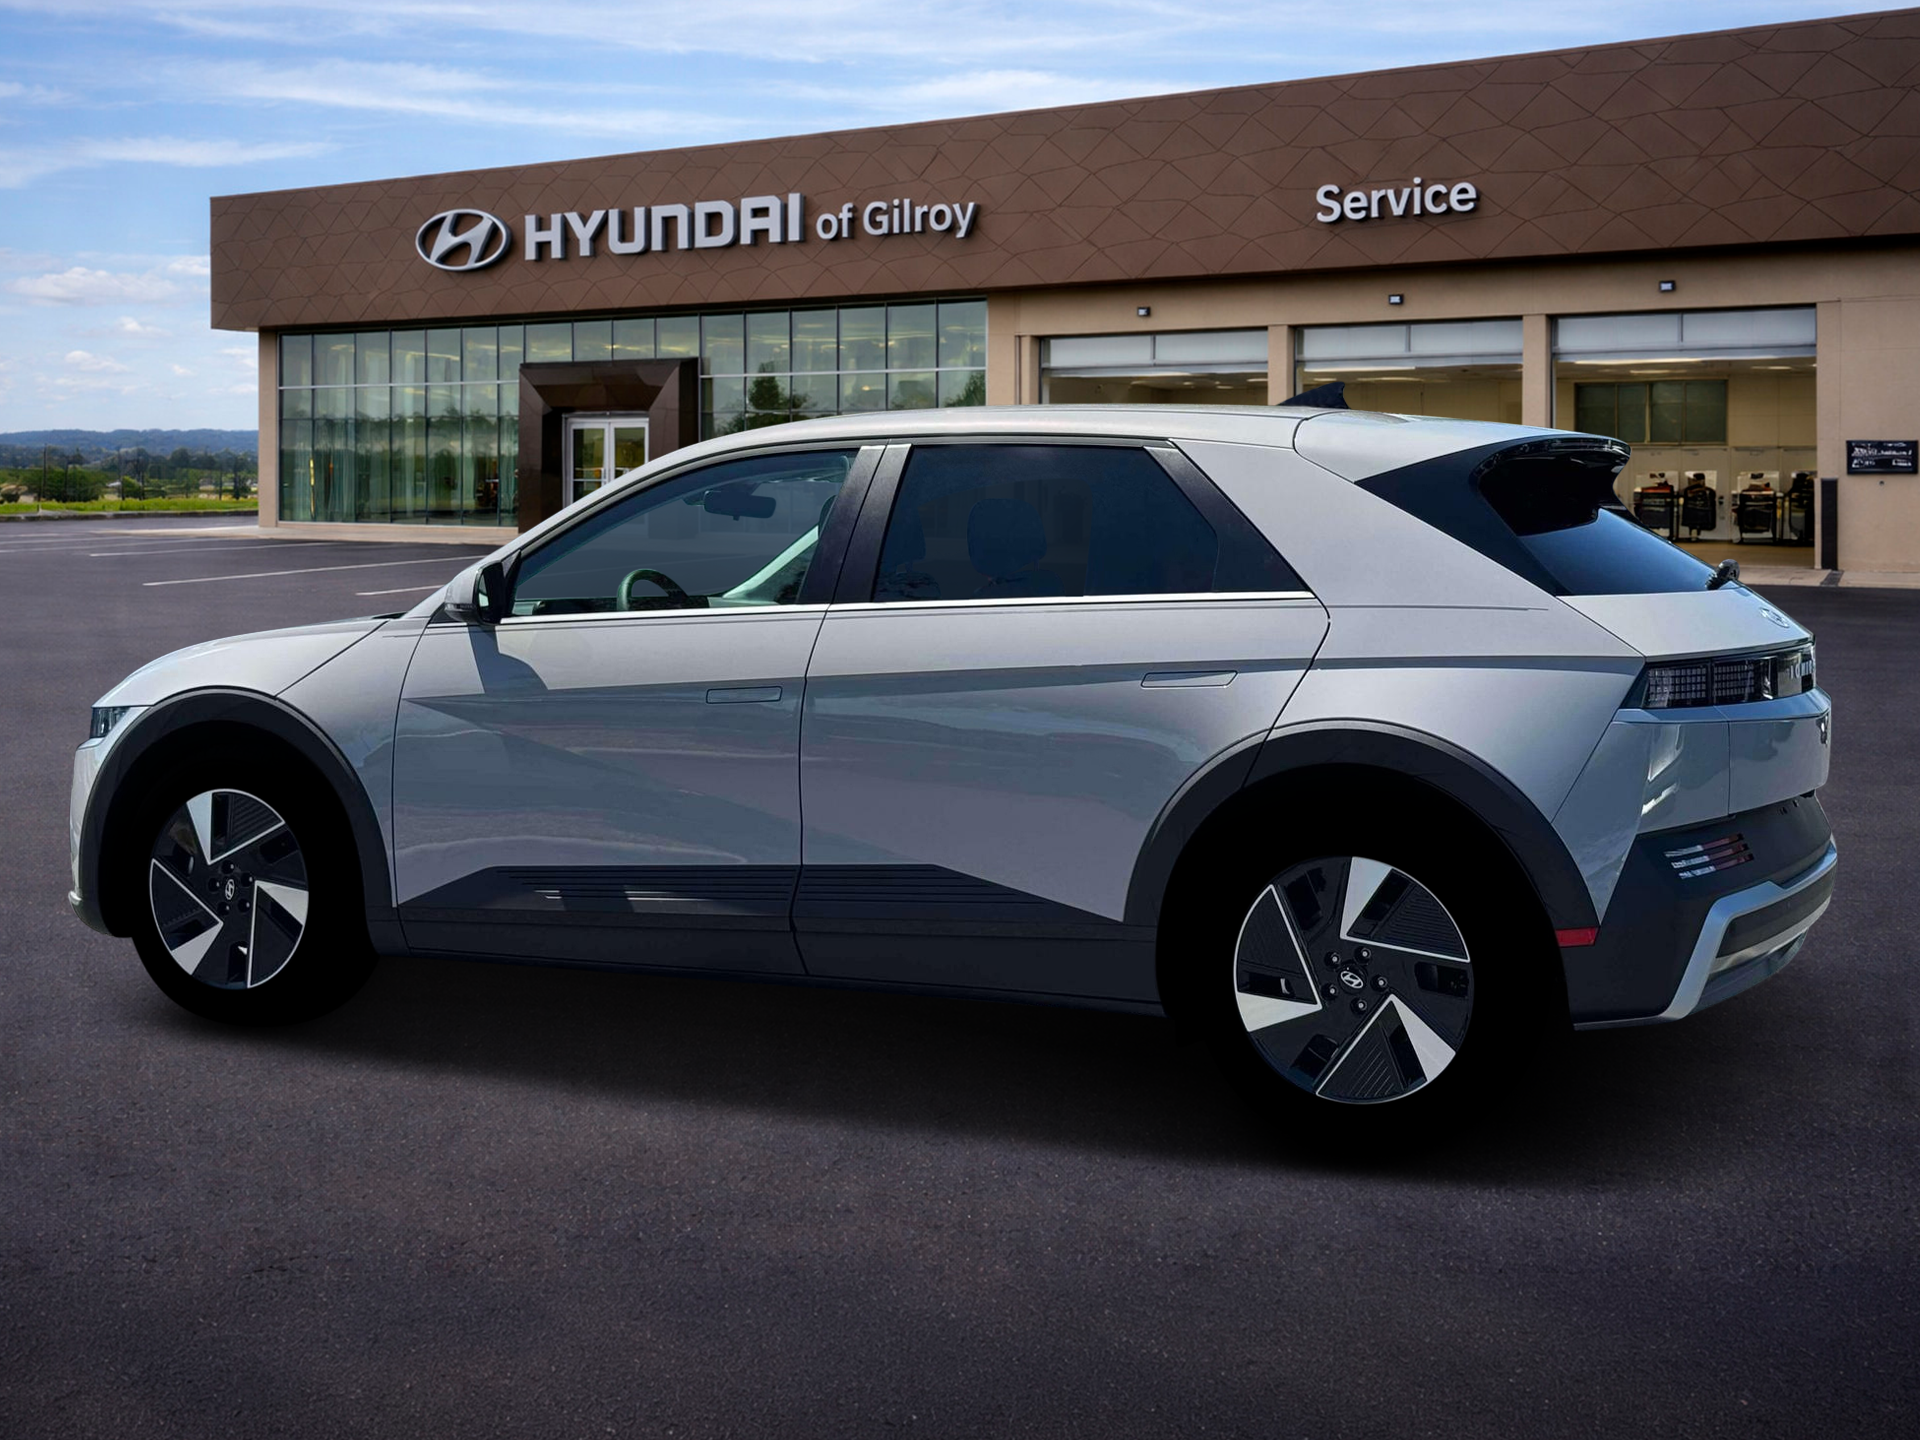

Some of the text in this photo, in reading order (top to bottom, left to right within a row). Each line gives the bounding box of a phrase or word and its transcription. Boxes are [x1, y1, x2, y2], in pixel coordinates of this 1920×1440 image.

[525, 193, 802, 261] HYUNDAI
[816, 203, 855, 240] of
[863, 198, 976, 238] Gilroy
[1316, 176, 1477, 223] Service
